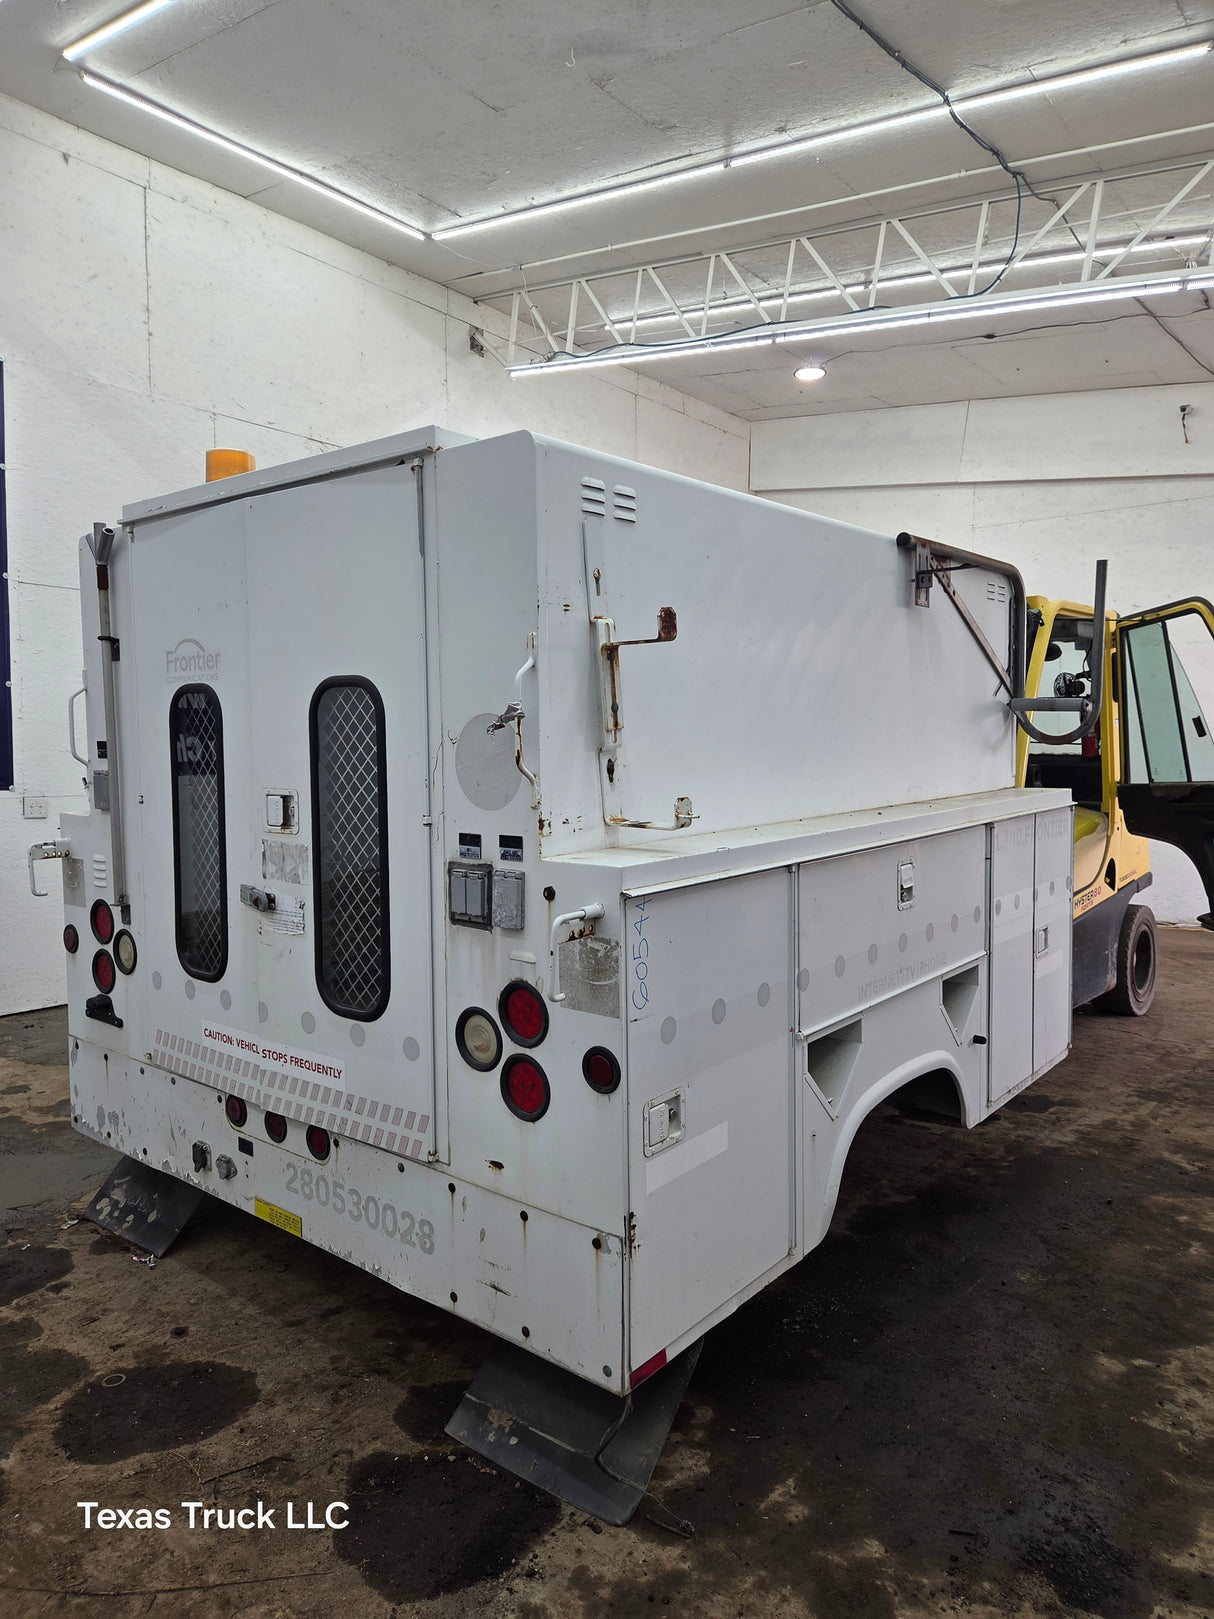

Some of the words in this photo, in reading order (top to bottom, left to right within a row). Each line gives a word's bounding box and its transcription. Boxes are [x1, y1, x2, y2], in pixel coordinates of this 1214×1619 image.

[166, 650, 221, 673] Frontier
[167, 672, 219, 684] COMMUNICATIONS
[631, 896, 653, 1010] 60544
[203, 1028, 235, 1046] CAUTION:
[261, 1048, 288, 1064] STOPS
[289, 1055, 343, 1080] FREQUENTLY
[285, 1161, 436, 1256] 280530028
